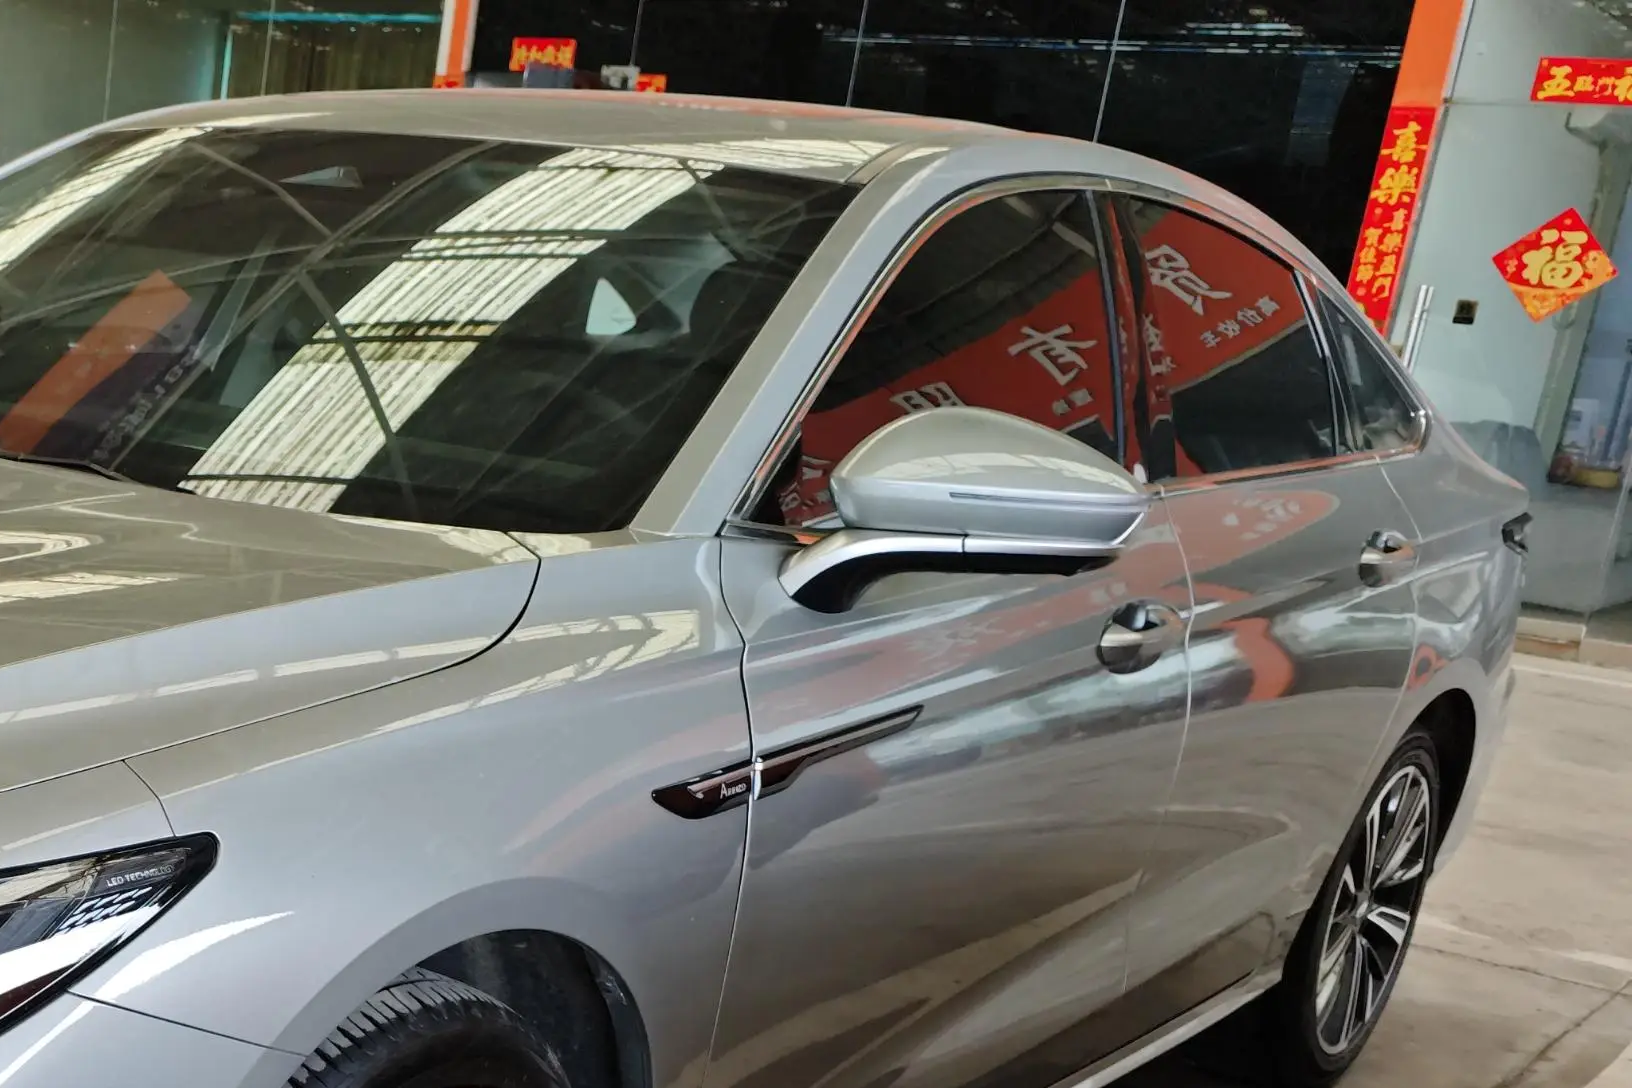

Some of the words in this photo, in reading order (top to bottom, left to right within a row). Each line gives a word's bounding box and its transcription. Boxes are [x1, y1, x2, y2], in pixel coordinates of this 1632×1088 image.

[1520, 228, 1589, 290] 福
[106, 875, 124, 887] LED
[124, 864, 176, 882] TECHNOLOGY
